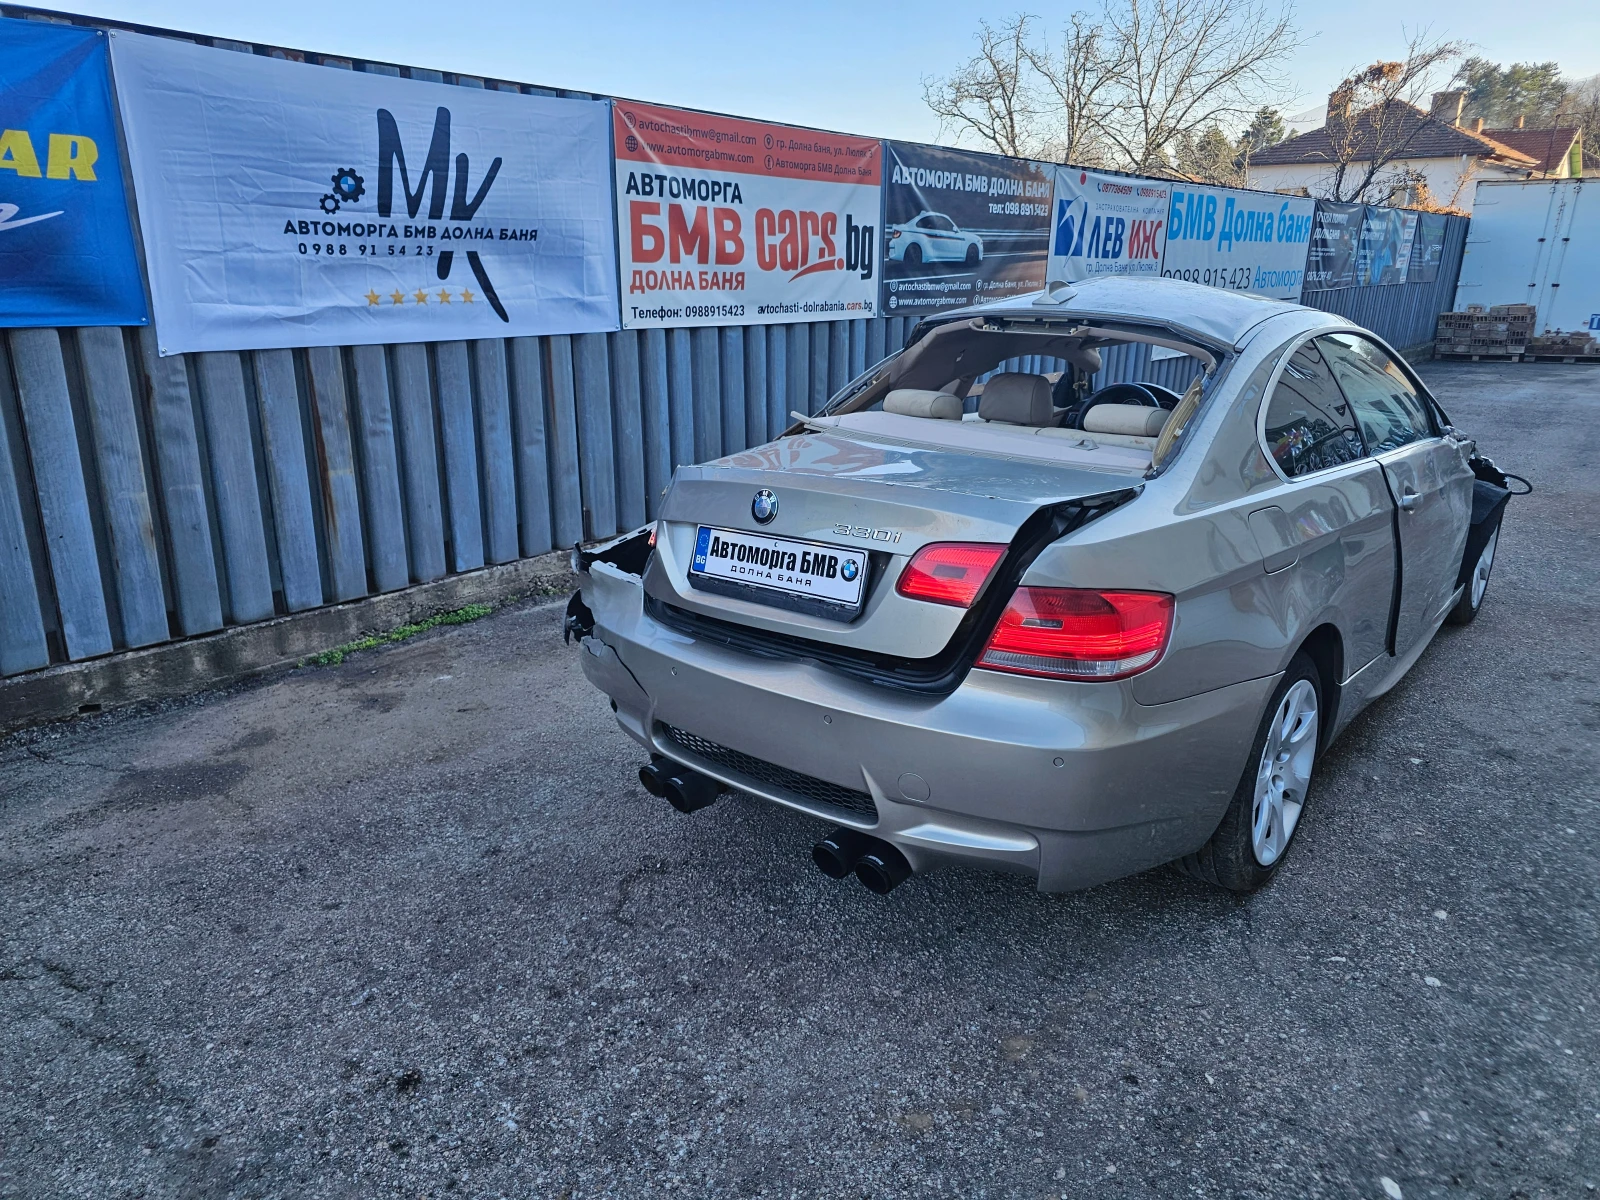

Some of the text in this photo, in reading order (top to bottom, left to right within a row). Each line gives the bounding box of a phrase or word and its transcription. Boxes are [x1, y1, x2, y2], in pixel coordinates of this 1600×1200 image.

[639, 118, 757, 147] avtochastibmw@gmail.com
[641, 141, 755, 165] www.avtomorgabmw.com
[776, 140, 787, 150] гр.
[788, 140, 812, 153] Долна
[776, 157, 872, 177] Автоморга БМВ Долна Баня
[625, 171, 743, 204] АВТОМОРГА
[892, 165, 1050, 198] АВТОМОРГА БМВ ДОЛНА БАНЯ
[1004, 203, 1019, 215] 098
[284, 219, 538, 242] АВТОМОРГА БМВ ДОЛНА БАНЯ
[630, 200, 745, 265] БМВ
[1168, 191, 1312, 252] БМВ Долна баня
[298, 242, 434, 256] 0988 91 54 23
[755, 207, 874, 281] cars.bg
[1087, 216, 1162, 260] ЛЕВ ИНС
[630, 270, 745, 294] ДОЛНА БАНЯ
[1203, 267, 1227, 288] 915
[1229, 267, 1251, 289] 423
[1252, 265, 1302, 292] Автоморга
[757, 300, 873, 315] avtochasti-dolnabania.cars.bg
[899, 296, 967, 307] www.avtomorgabmw.com
[631, 305, 745, 322] Телефон: 0988915423
[833, 522, 902, 544] 330i
[695, 554, 706, 566] BG
[709, 536, 839, 579] Автоморга БМВ
[730, 564, 813, 587] ДОЛНА БАНЯ
